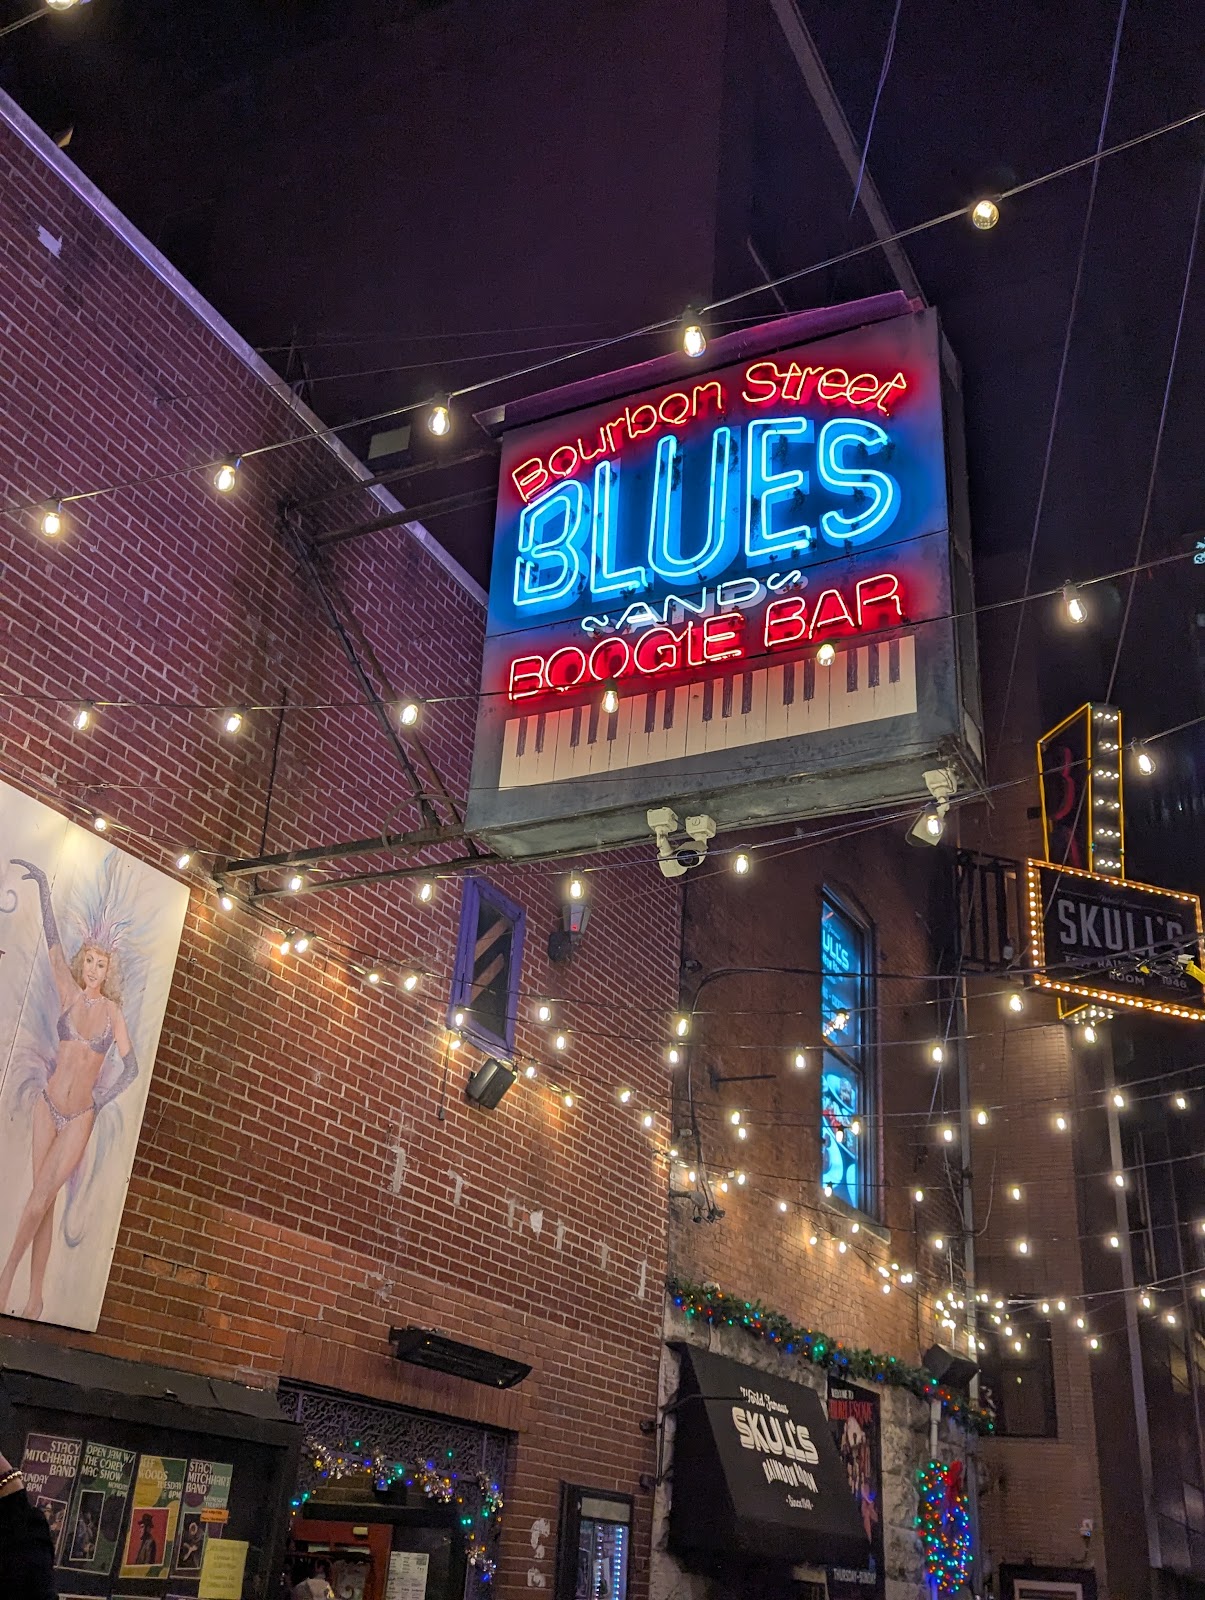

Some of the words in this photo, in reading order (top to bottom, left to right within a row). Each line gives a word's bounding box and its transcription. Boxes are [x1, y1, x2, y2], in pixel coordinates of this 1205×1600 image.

[512, 381, 722, 503] Bourbon
[742, 362, 907, 416] Street
[513, 416, 898, 608] BLUES
[615, 575, 762, 632] AND
[508, 612, 744, 700] BOOGIE
[764, 573, 903, 647] BAR
[732, 1406, 819, 1465] SKULL'S
[50, 1440, 80, 1455] STACY
[85, 1444, 107, 1458] OPEN
[107, 1448, 122, 1460] JAM
[24, 1448, 79, 1466] MITCHHART
[84, 1454, 98, 1466] THE
[99, 1458, 126, 1472] COREY
[49, 1464, 76, 1478] BAND
[80, 1465, 99, 1478] MAC
[99, 1469, 123, 1482] SHOW
[189, 1461, 213, 1474] STACY
[20, 1472, 49, 1484] SUNDAY
[187, 1471, 231, 1487] MITCHHART
[26, 1483, 43, 1493] 8PM
[186, 1482, 207, 1495] BAND
